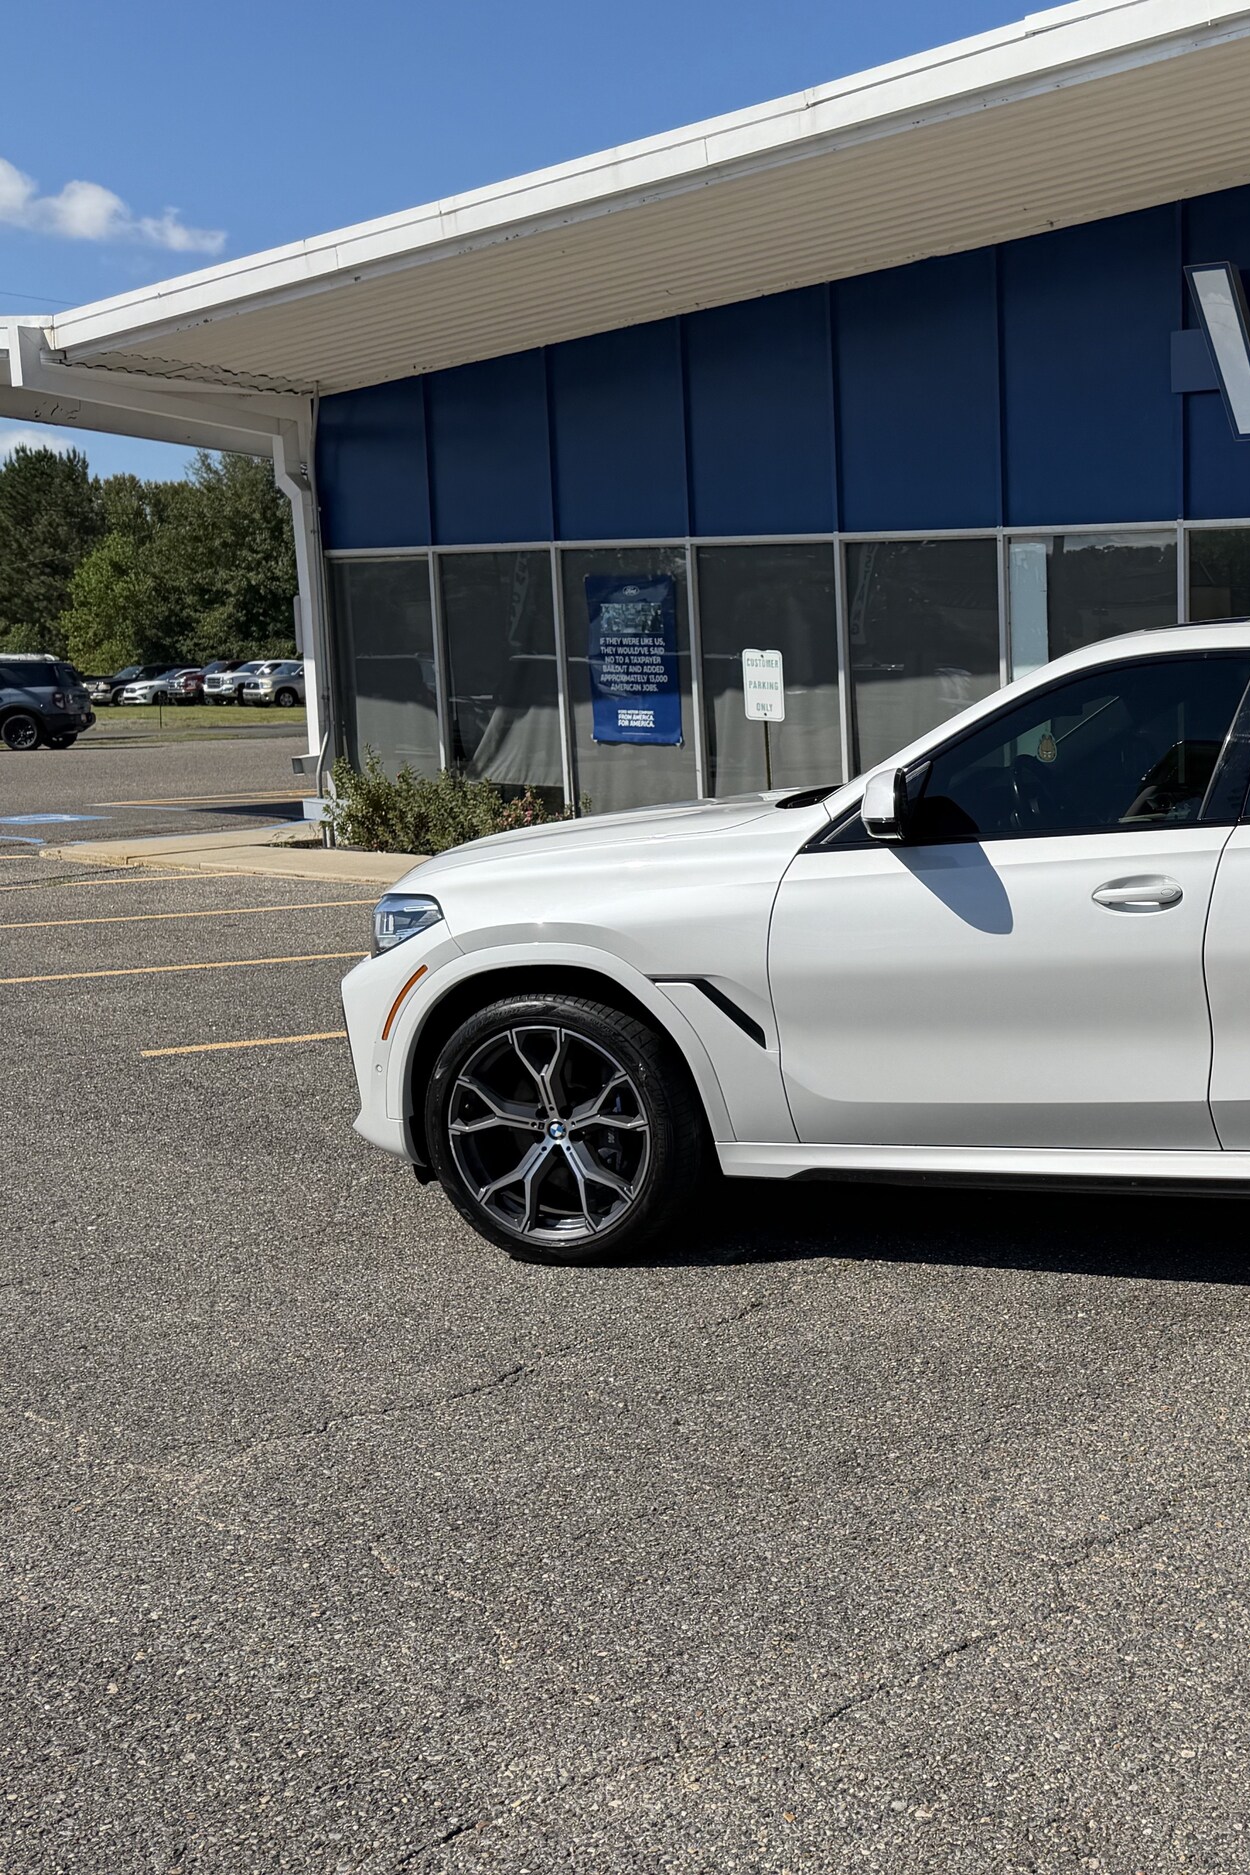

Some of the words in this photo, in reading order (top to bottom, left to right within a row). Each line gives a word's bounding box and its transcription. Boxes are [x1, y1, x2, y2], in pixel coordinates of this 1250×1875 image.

[654, 638, 665, 646] US,
[650, 647, 665, 655] SAID
[630, 656, 661, 664] TAXPAYER
[747, 658, 778, 668] CUSTOMER
[601, 674, 648, 682] APPROXIMATELY
[611, 683, 641, 691] AMERICAN
[749, 680, 778, 690] PARKING
[756, 703, 773, 712] ONLY
